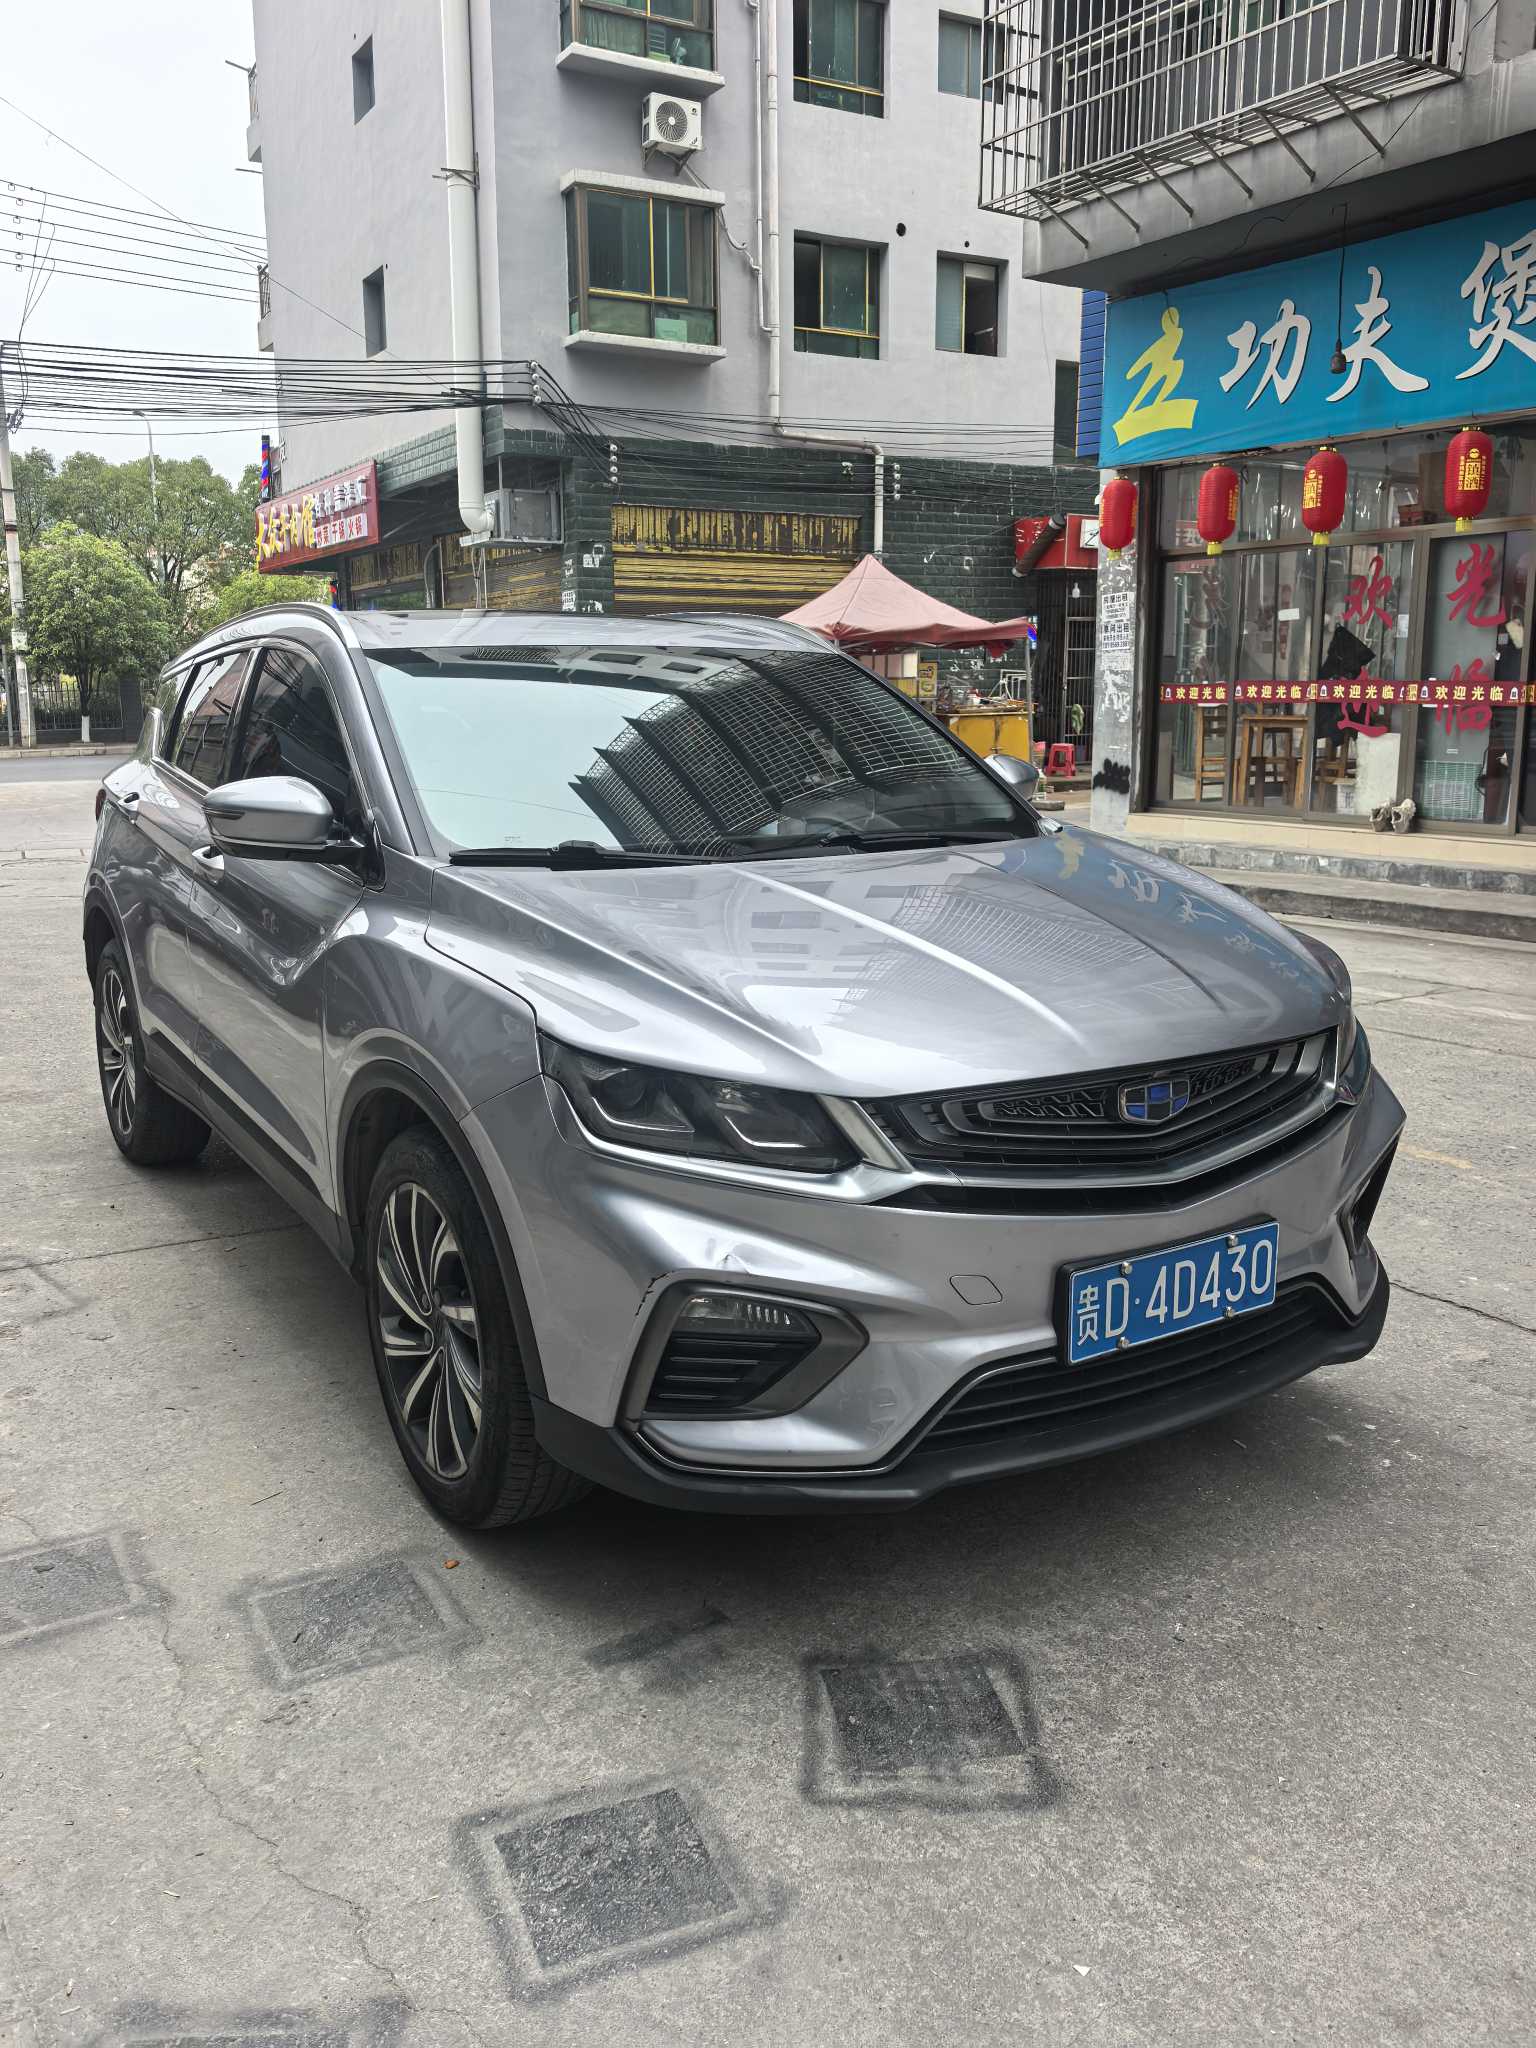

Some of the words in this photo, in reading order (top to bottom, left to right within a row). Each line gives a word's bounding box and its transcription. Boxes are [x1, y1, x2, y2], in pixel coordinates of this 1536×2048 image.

[1176, 687, 1226, 700] 欢迎光临
[1247, 685, 1301, 699] 欢迎光临
[1333, 684, 1394, 700] 欢迎光临
[1435, 685, 1503, 701] 欢迎光临
[1077, 1239, 1272, 1346] 贵D·4D430
